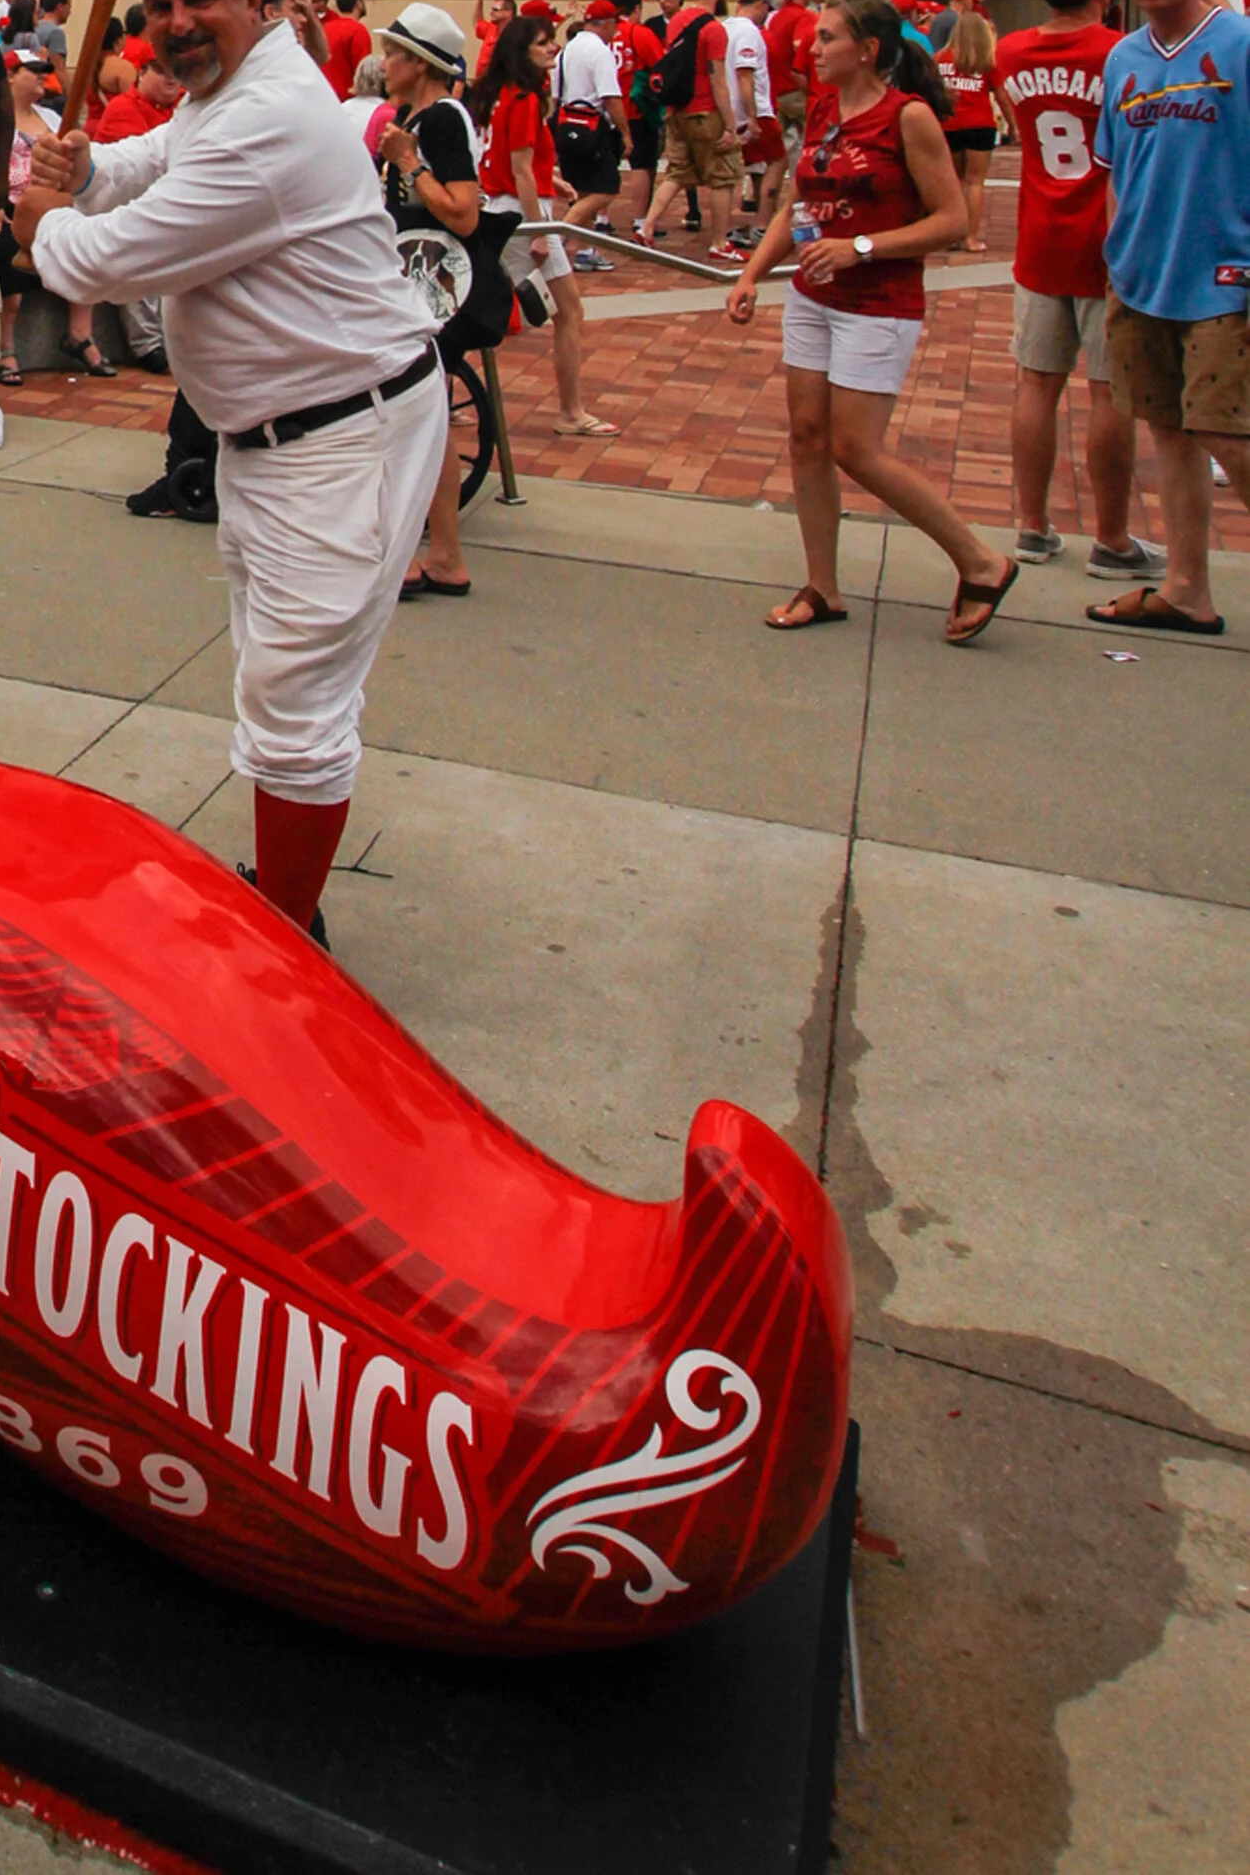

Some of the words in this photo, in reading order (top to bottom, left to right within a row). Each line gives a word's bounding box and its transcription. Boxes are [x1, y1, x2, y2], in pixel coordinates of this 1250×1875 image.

[943, 77, 984, 92] ACHINE
[1004, 67, 1104, 106] MORGAN
[1035, 110, 1092, 180] 8
